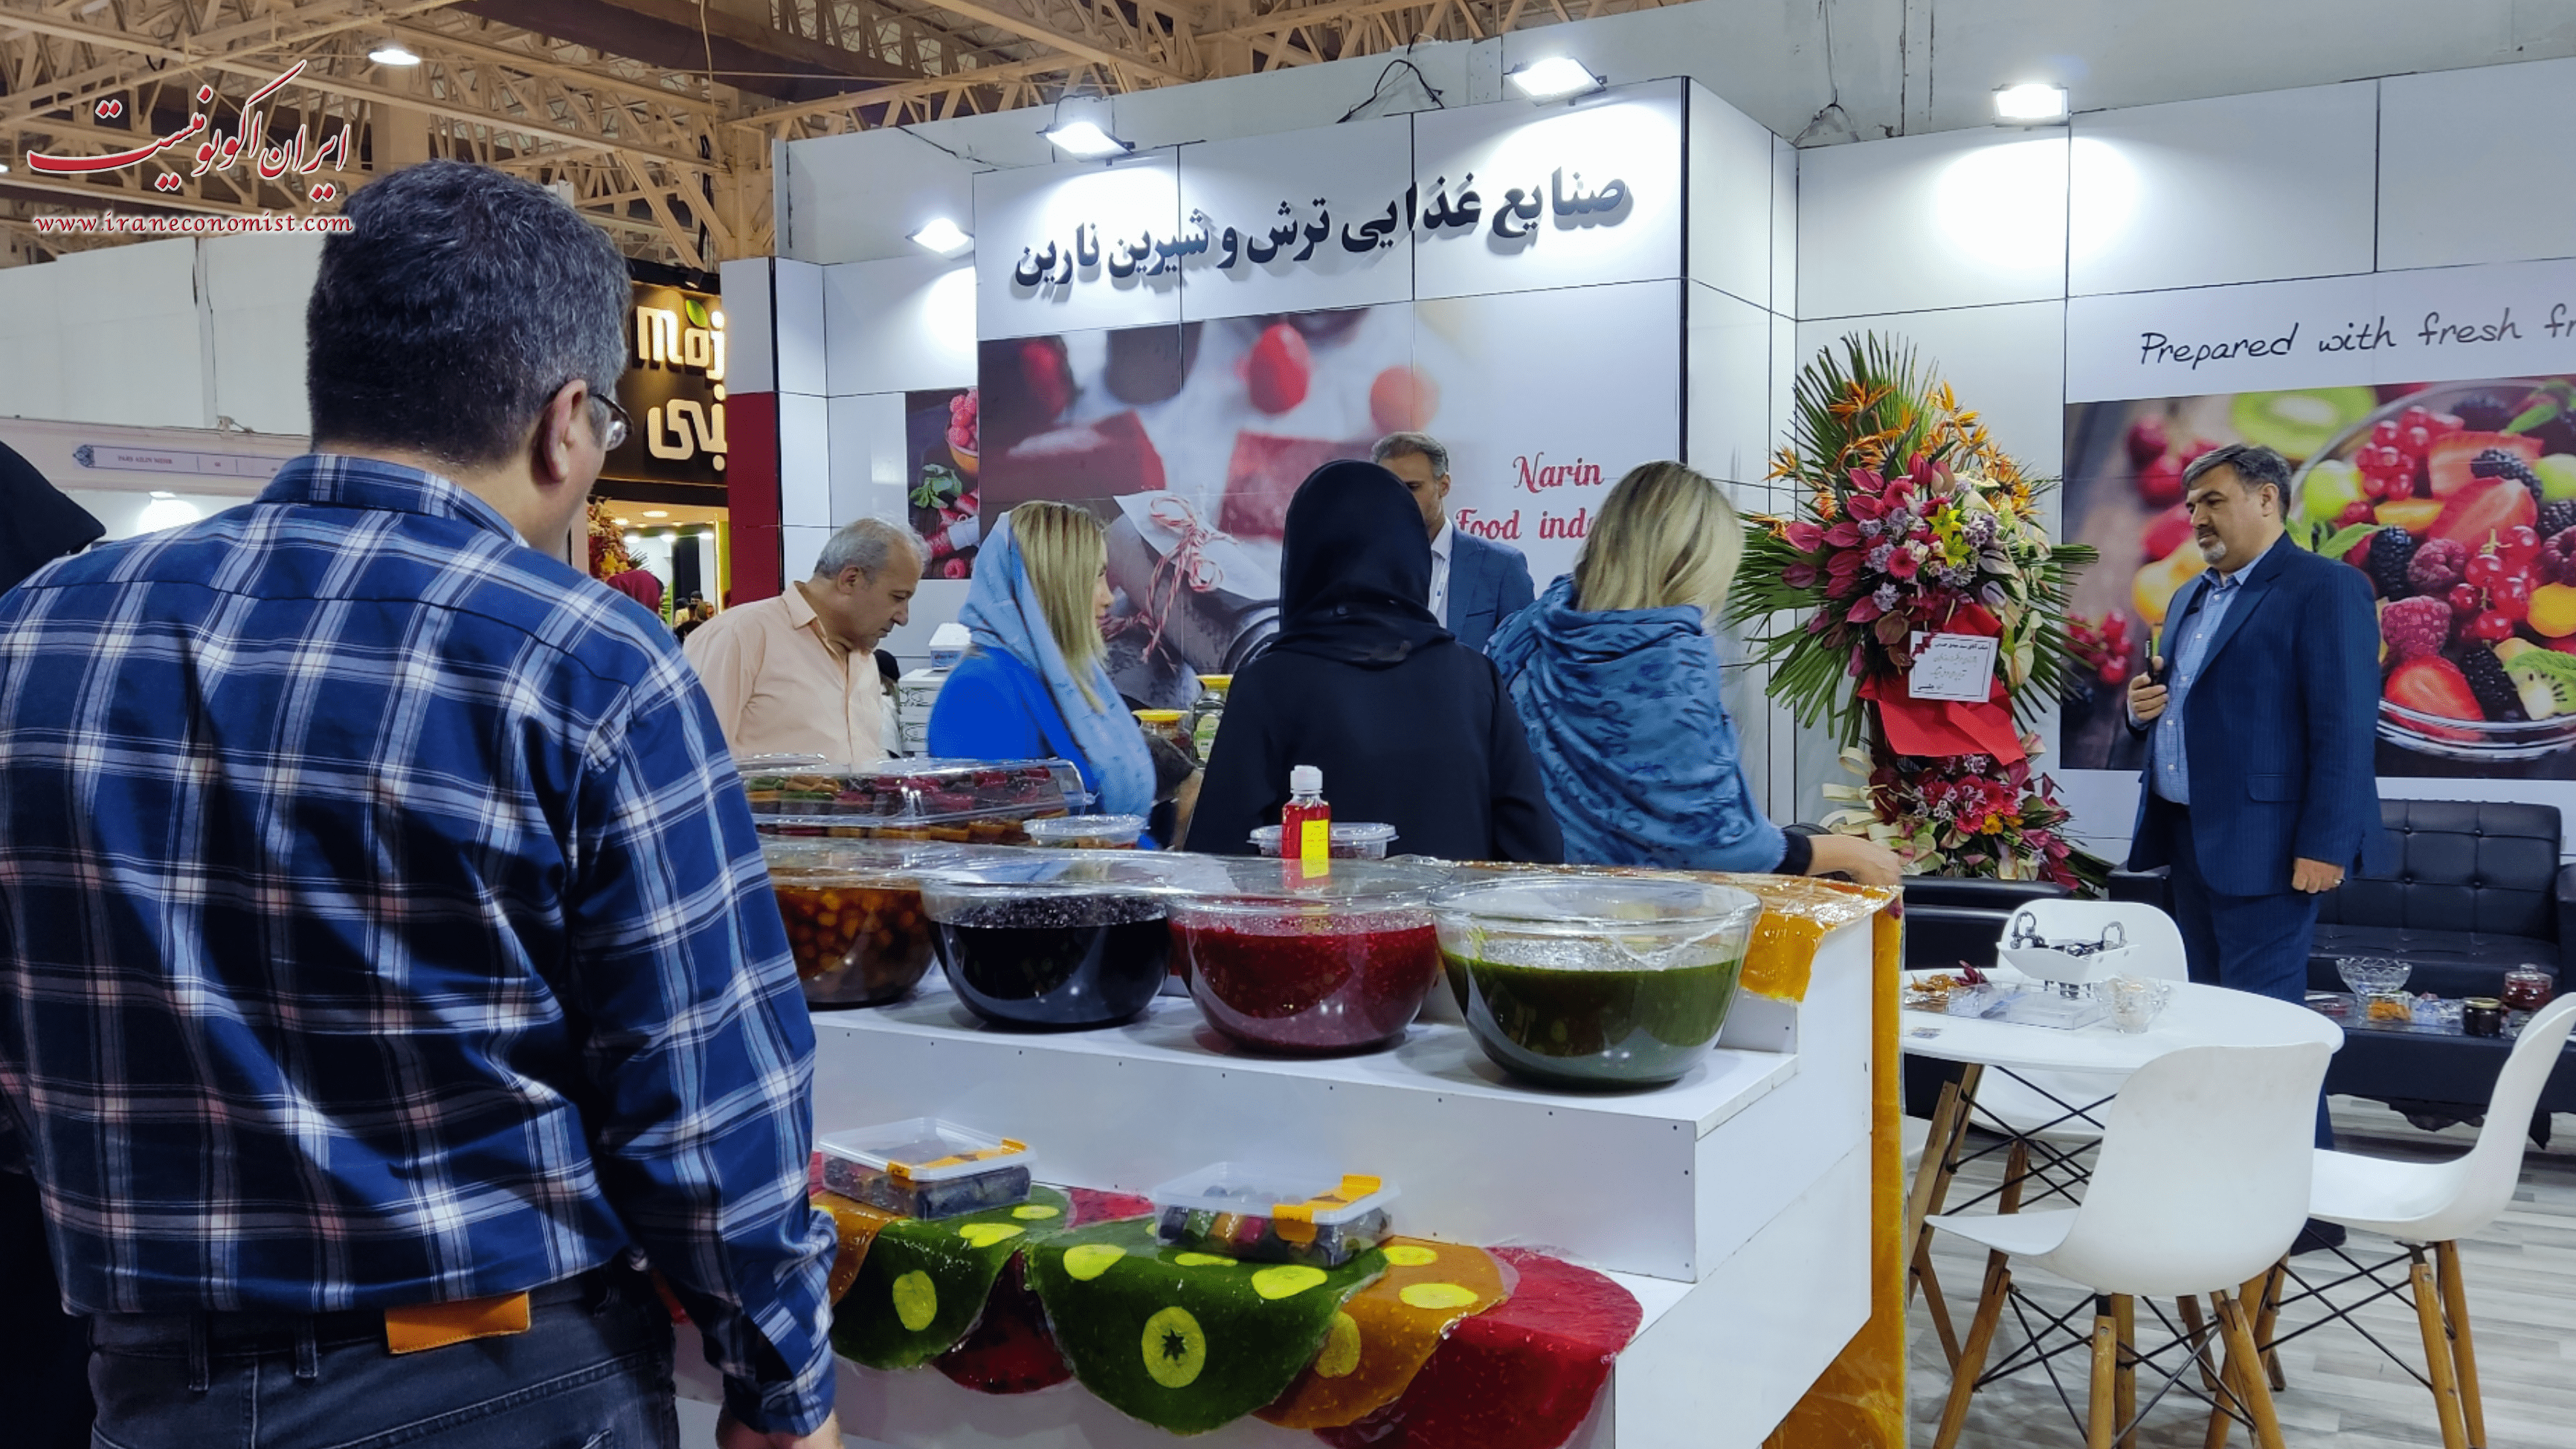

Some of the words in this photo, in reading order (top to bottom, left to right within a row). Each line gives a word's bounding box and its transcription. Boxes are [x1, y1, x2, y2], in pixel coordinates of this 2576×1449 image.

[1247, 197, 1332, 263] ترش
[1342, 172, 1482, 253] غذایی
[1493, 167, 1629, 239] صنایع
[1016, 222, 1101, 287] نارین
[1109, 208, 1210, 278] شیرین
[1217, 226, 1239, 269] و
[2141, 323, 2299, 370] Prepared
[2319, 316, 2398, 353] with
[2418, 306, 2523, 346] fresh
[1513, 451, 1606, 494] Narin
[1456, 509, 1522, 540] Food
[1539, 507, 1596, 539] ind
